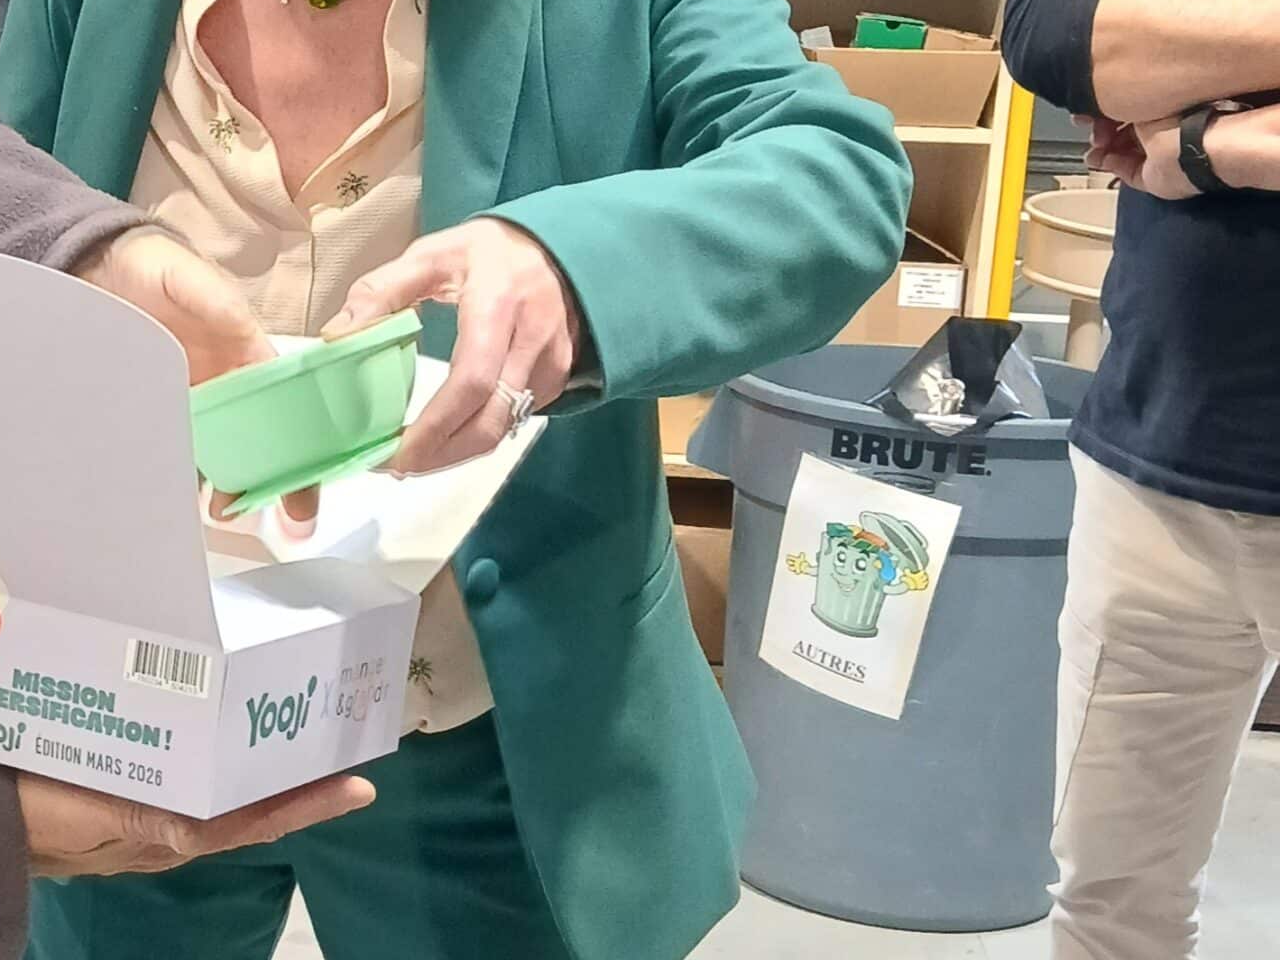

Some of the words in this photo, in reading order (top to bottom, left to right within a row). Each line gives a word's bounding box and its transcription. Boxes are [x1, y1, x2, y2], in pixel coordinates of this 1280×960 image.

[793, 640, 867, 680] AUTRES
[12, 668, 116, 713] MISSION
[246, 675, 318, 748] Yooji
[35, 732, 82, 765] ÉDITION
[86, 751, 123, 776] MARS
[128, 762, 163, 787] 2026
